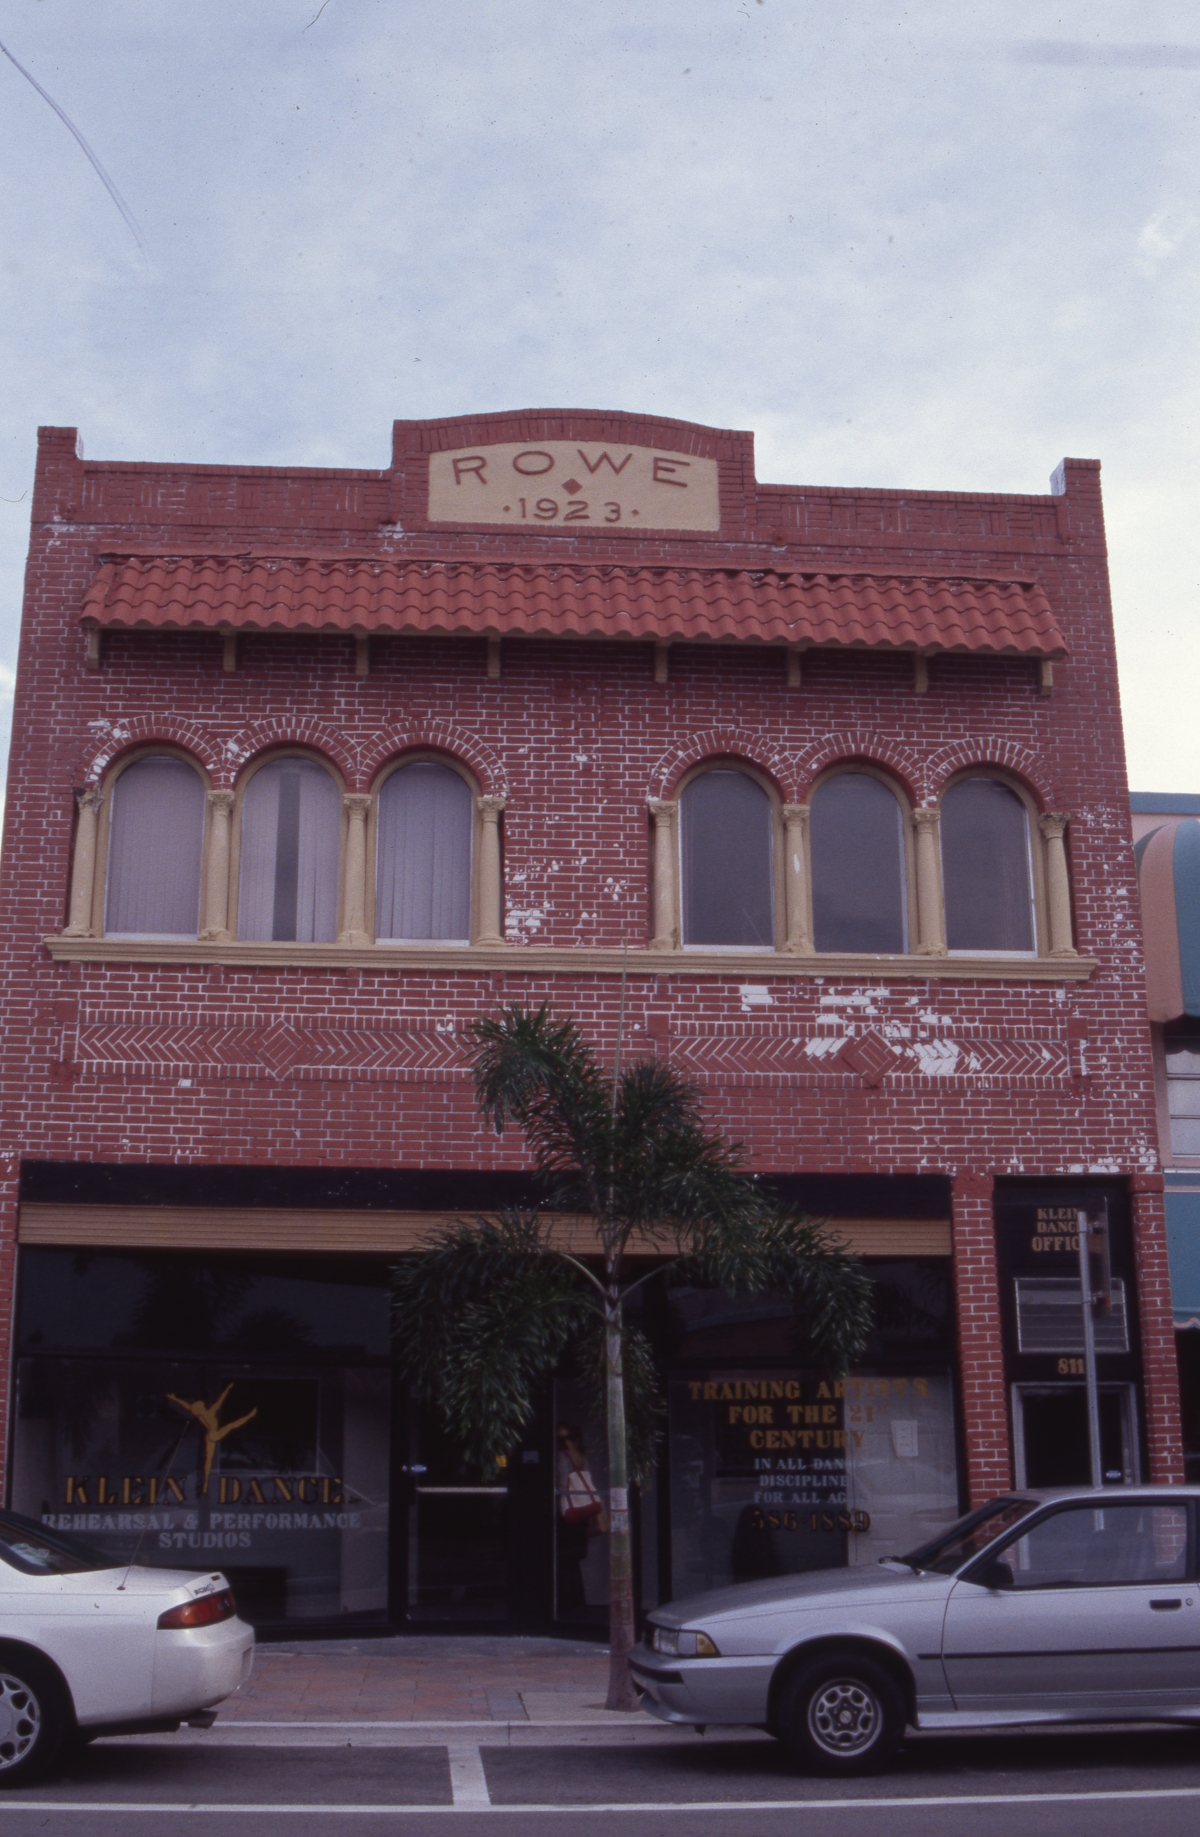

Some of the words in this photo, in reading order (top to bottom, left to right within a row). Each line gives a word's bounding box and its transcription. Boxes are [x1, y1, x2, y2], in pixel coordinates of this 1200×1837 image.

[452, 449, 690, 488] ROWE
[519, 498, 622, 523] 1923
[1031, 1236, 1080, 1251] OFFIC
[1058, 1358, 1085, 1374] 811
[688, 1381, 801, 1400] TRAINING
[816, 1376, 929, 1400] ARTISTS
[728, 1405, 774, 1424] FOR
[786, 1405, 838, 1424] THE
[750, 1430, 866, 1449] CENTURY
[754, 1458, 772, 1470] IN
[776, 1458, 806, 1470] ALL
[64, 1476, 188, 1504] KLEIN
[217, 1476, 345, 1504] DANCE
[754, 1492, 783, 1504] FOR
[791, 1492, 820, 1504] ALL
[42, 1513, 173, 1530] REHEARSAL
[183, 1514, 199, 1529] &
[210, 1513, 361, 1529] PERFORMANCE
[158, 1532, 252, 1548] STUDIOS
